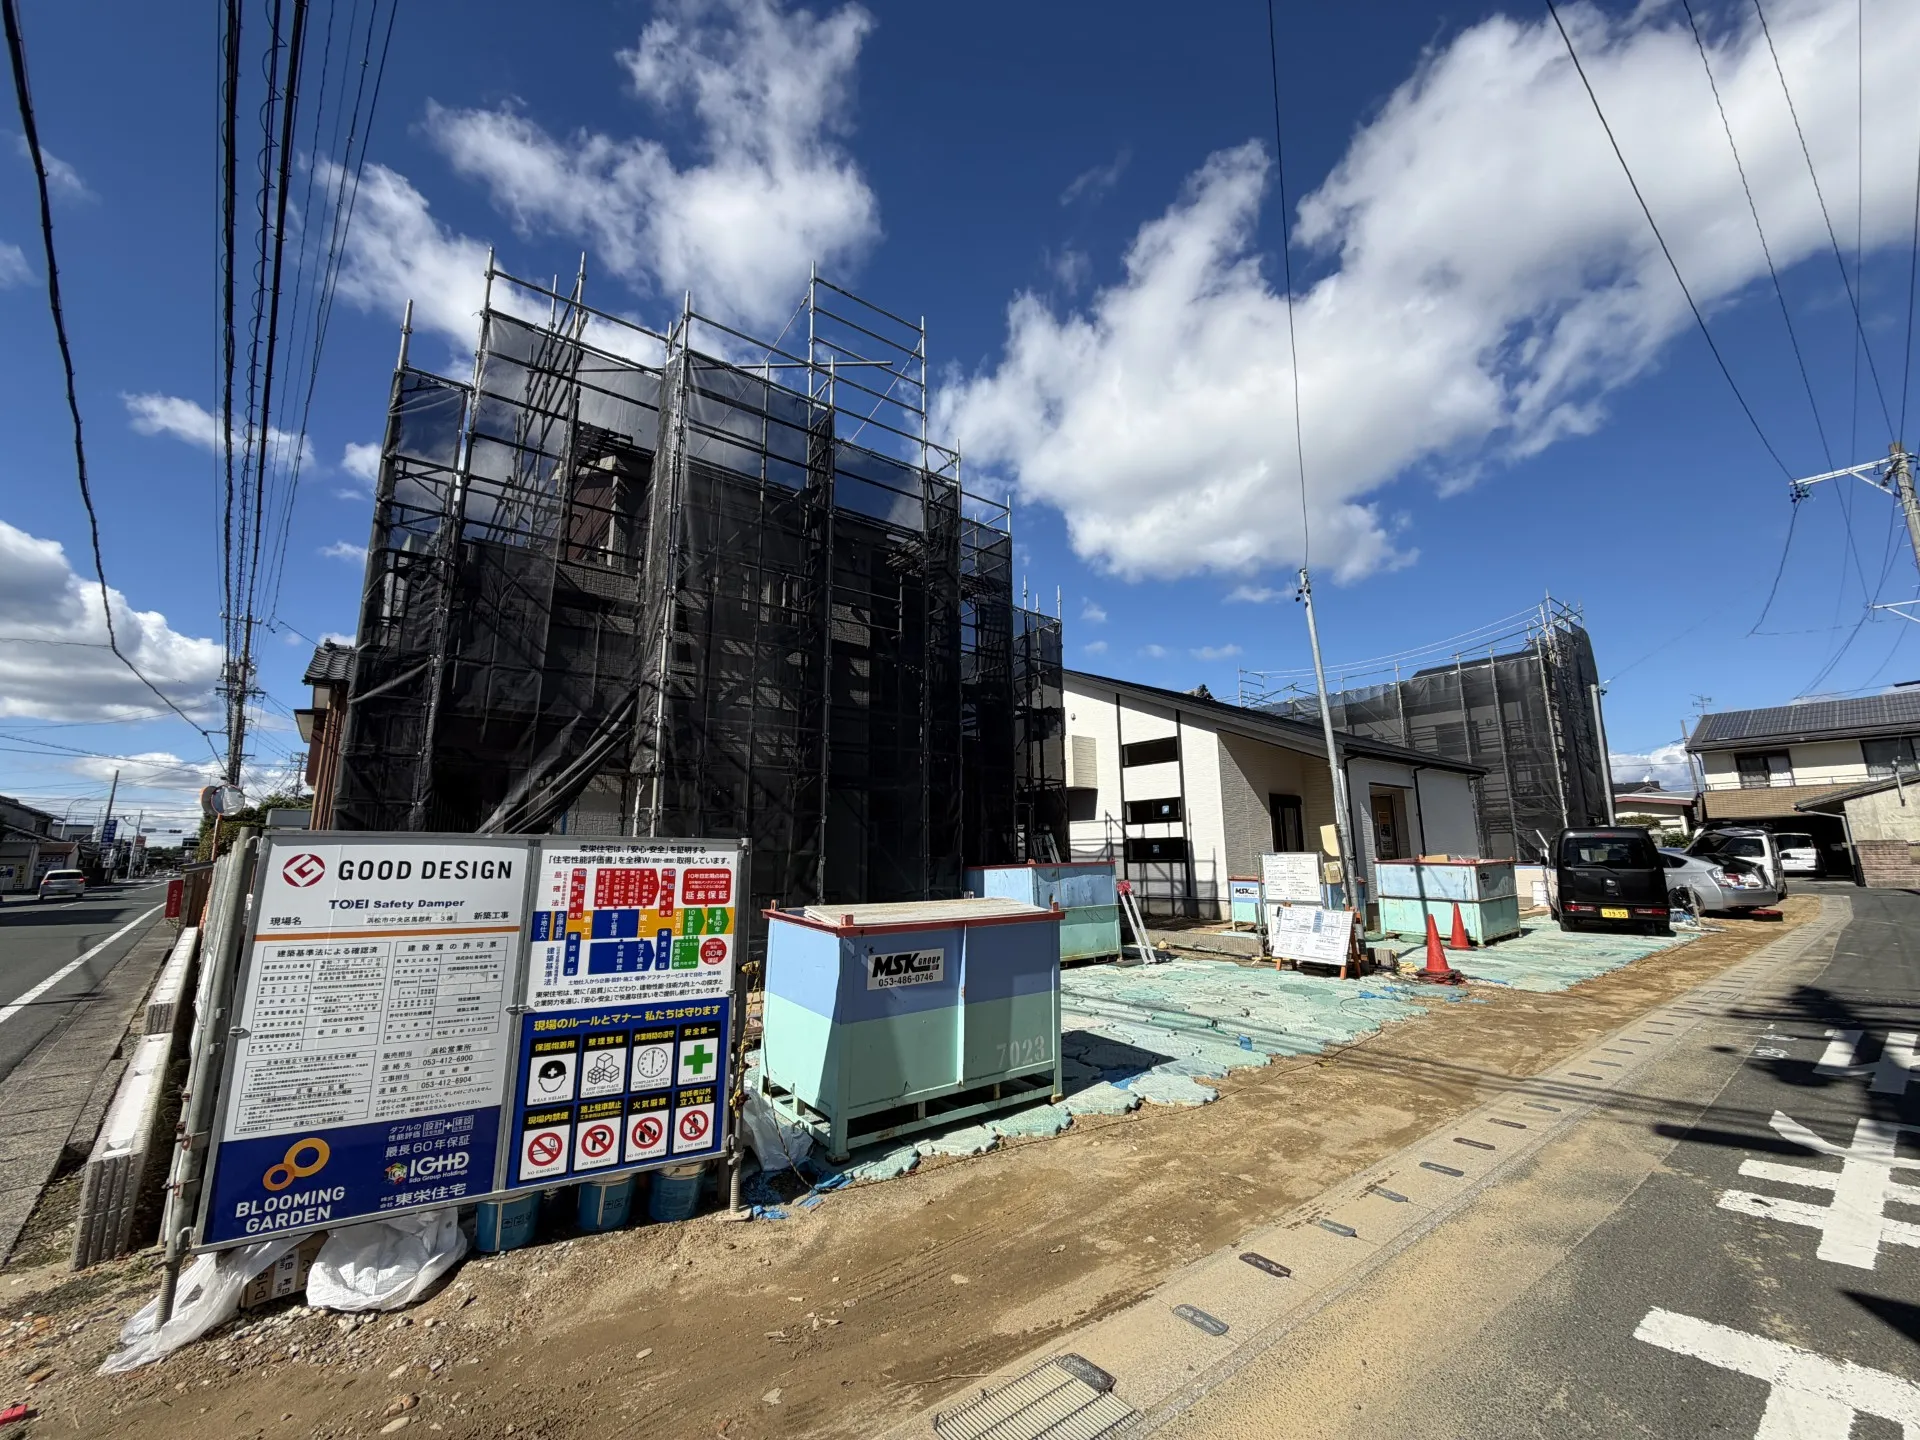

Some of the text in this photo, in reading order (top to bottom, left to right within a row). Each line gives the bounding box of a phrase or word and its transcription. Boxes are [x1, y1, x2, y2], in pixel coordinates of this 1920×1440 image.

[338, 860, 513, 881] GOOD DESIGN
[685, 890, 728, 900] 延長保証
[328, 899, 465, 910] TOEI Safety Damper
[270, 917, 302, 926] 現場名
[473, 911, 509, 921] 新築工事
[687, 909, 696, 933] 10年保証
[539, 914, 548, 939] 土地仕入
[277, 946, 378, 958] 建築基準法による確認済
[408, 941, 497, 952] 建設業の許可票
[872, 952, 941, 977] MSK GROUP
[878, 972, 934, 988] 053-486-0746
[533, 1005, 721, 1032] 現場のルールとマナー 私たちは守ります
[684, 1026, 716, 1036] 安全第一
[535, 1040, 575, 1052] 保護帽着用
[588, 1035, 624, 1047] 整理整頓
[383, 1050, 413, 1060] 販売担当
[430, 1043, 472, 1055] 浜松営業所
[996, 1035, 1045, 1067] 7023
[422, 1054, 474, 1066] 053-412-6900
[381, 1062, 412, 1072] 連絡先
[380, 1073, 410, 1083] 工事担当
[420, 1076, 472, 1089] 053-412-6904
[378, 1085, 409, 1095] 連絡先
[679, 1088, 712, 1099] 関係者以外
[580, 1100, 622, 1113] 路上駐車禁止
[632, 1097, 667, 1110] 火気厳禁
[679, 1095, 712, 1106] 立入禁止
[527, 1111, 569, 1125] 現場内禁煙
[389, 1123, 421, 1134] ダブルの
[425, 1121, 443, 1131] 設計
[388, 1131, 421, 1142] 性能評価
[385, 1134, 471, 1158] 最長60年保証
[410, 1151, 470, 1177] IGHD
[590, 1157, 611, 1165] PARKING
[422, 1174, 442, 1182] Group
[442, 1169, 468, 1178] Holdings
[394, 1183, 467, 1206] 東栄住宅
[235, 1186, 345, 1218] BLOOMING
[245, 1205, 331, 1233] GARDEN
